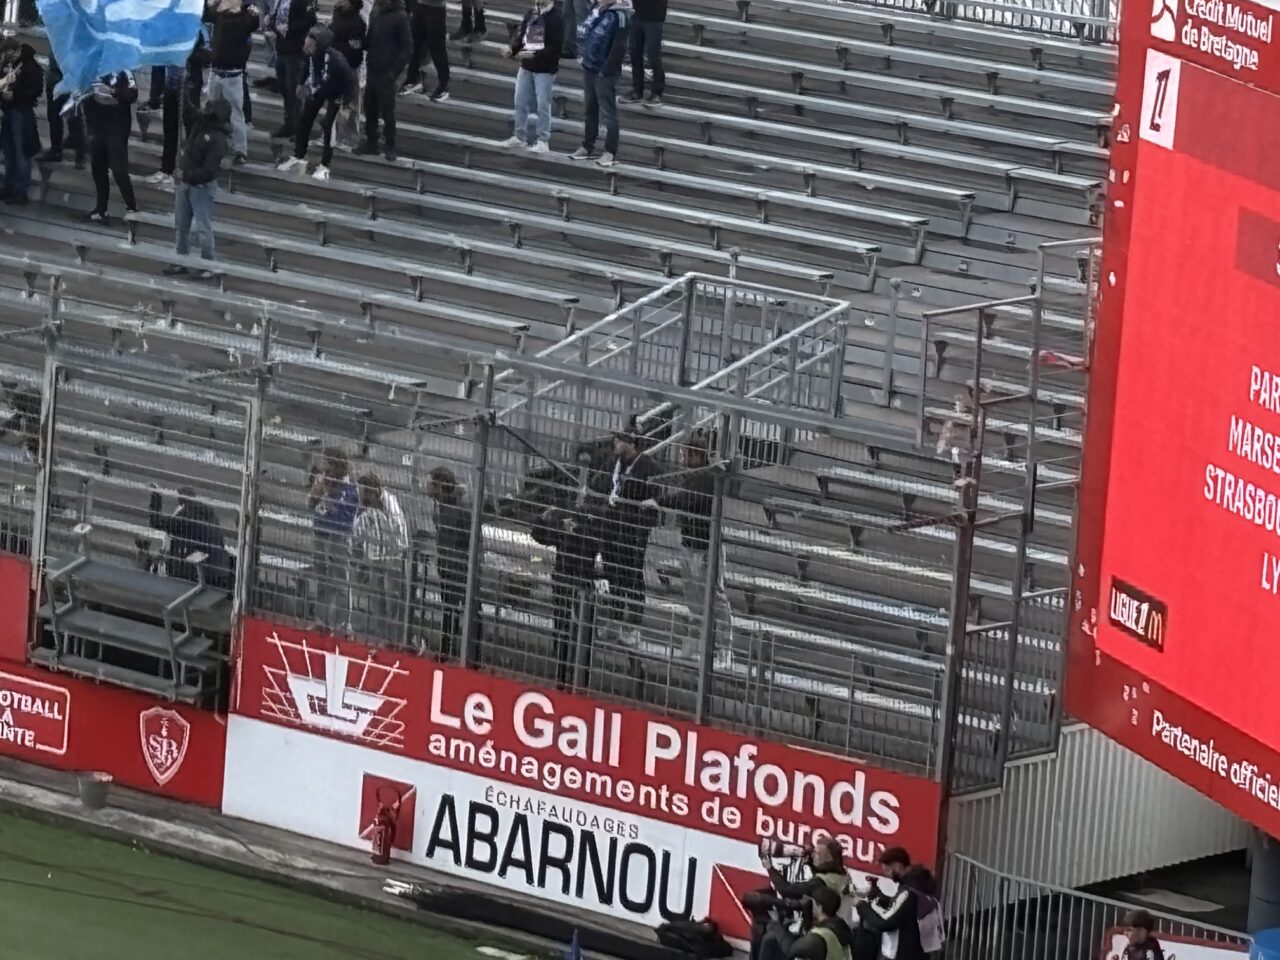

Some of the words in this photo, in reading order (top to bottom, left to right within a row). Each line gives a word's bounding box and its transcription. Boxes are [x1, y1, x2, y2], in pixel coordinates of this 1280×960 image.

[1181, 18, 1199, 48] de
[1200, 25, 1259, 70] Bretagne
[1225, 3, 1273, 44] Mutuel
[429, 669, 495, 736] Le
[513, 691, 622, 768] Gall
[643, 720, 901, 836] Plafonds
[1151, 709, 1228, 777] Partenaire
[427, 733, 689, 817] aménagements
[701, 795, 743, 829] de
[755, 807, 888, 865] bureau
[484, 784, 640, 840] ÉCHAFAUDAGES
[424, 792, 698, 923] ABARNOU
